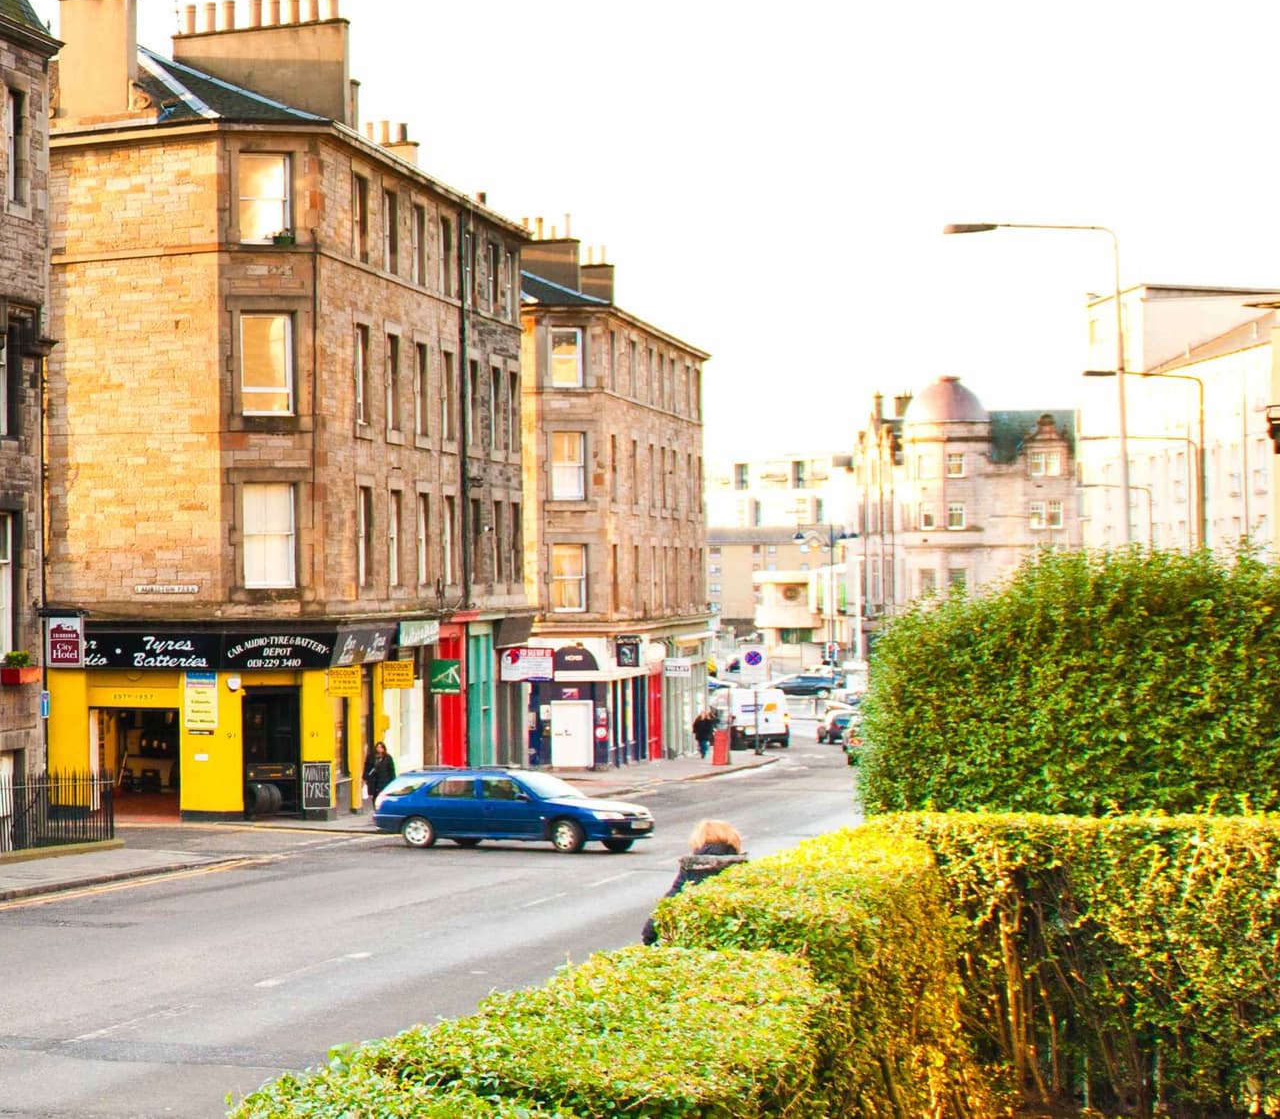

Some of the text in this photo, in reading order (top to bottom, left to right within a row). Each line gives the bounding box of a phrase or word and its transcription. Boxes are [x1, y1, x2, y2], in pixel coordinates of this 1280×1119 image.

[56, 643, 72, 652] City
[143, 636, 194, 653] Tyres
[227, 644, 244, 658] CAR
[53, 650, 78, 659] Hotel
[263, 647, 292, 657] DEPOT
[133, 652, 208, 667] Batteries
[281, 658, 302, 667] 3410
[304, 765, 329, 781] WINTER
[304, 782, 330, 798] TYRES
